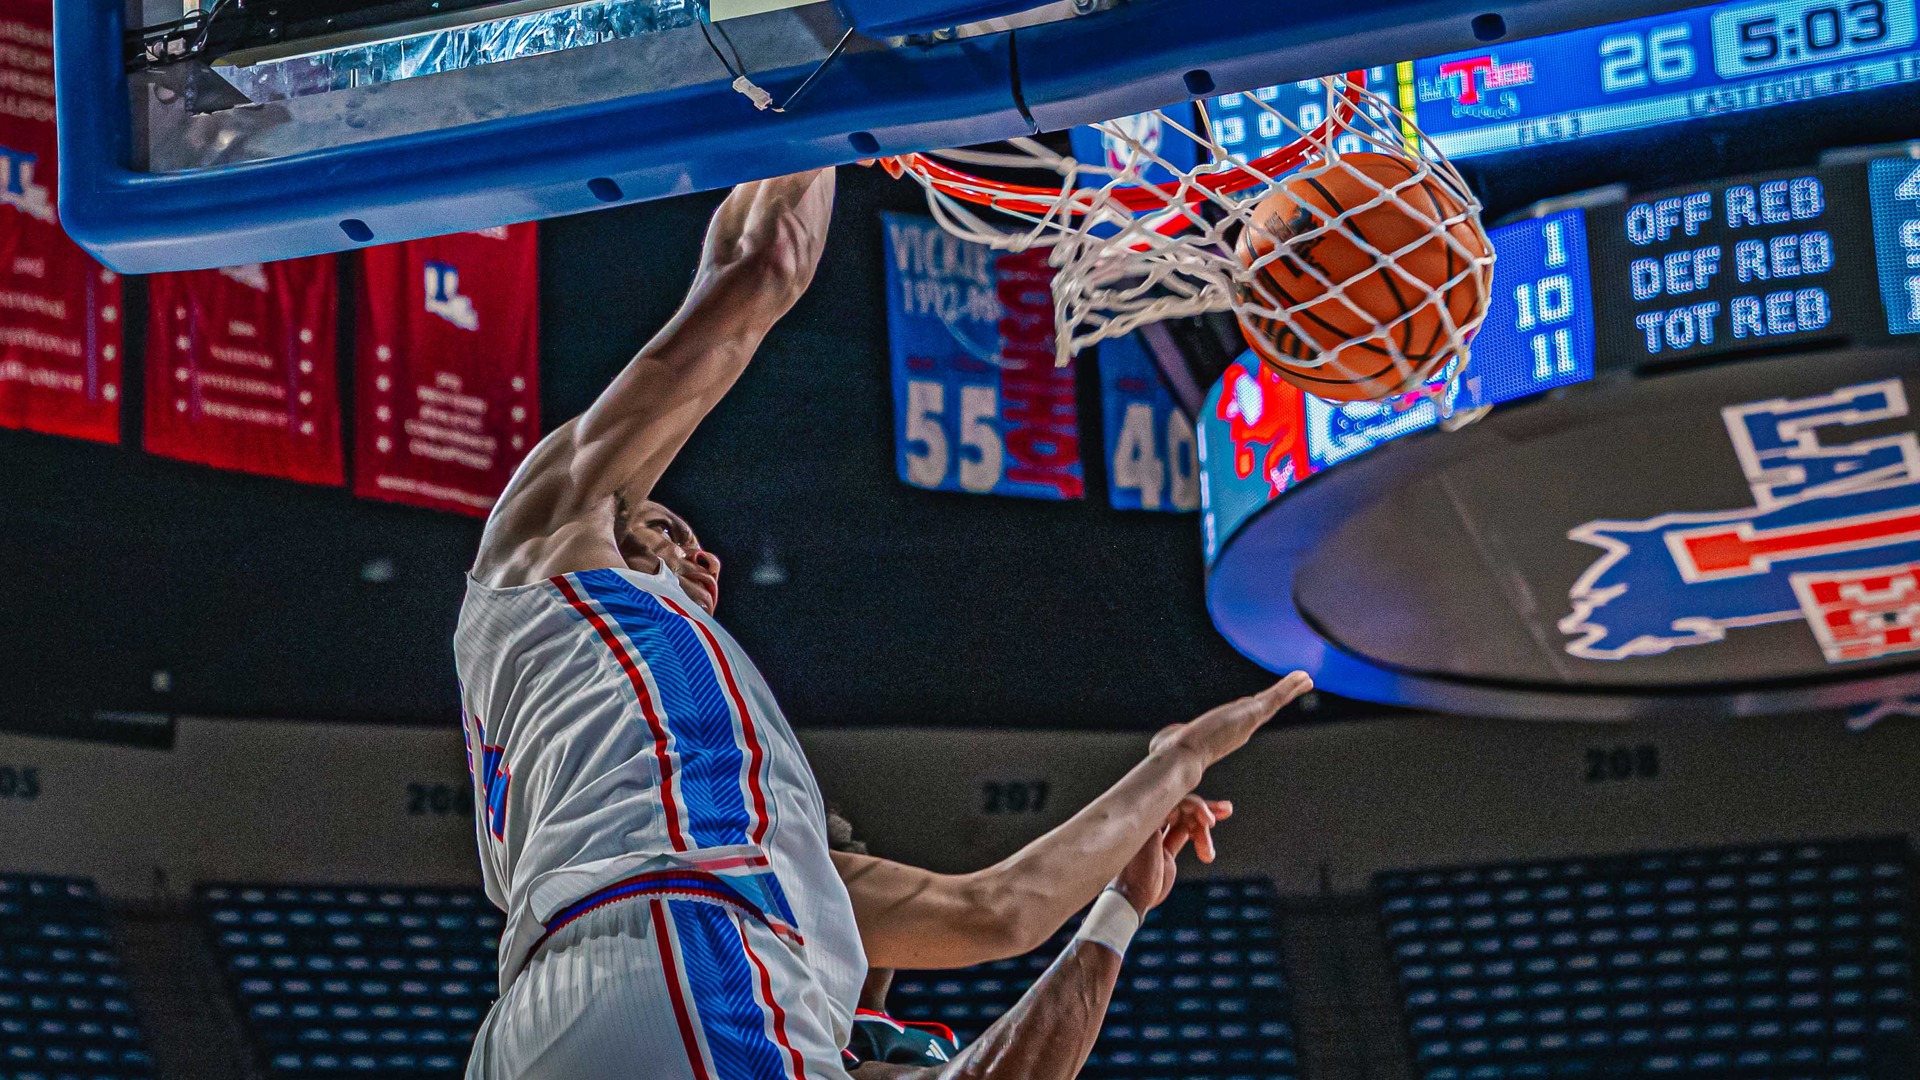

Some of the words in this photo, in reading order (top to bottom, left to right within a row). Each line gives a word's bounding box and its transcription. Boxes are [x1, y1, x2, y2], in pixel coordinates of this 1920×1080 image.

[1600, 22, 1697, 93] 26
[1740, 0, 1887, 63] 5:03
[1625, 191, 1712, 246] OFF
[1725, 176, 1824, 228] REB
[1542, 220, 1566, 268] 1
[1630, 245, 1721, 300] DEF
[1735, 230, 1834, 282] REB
[1513, 274, 1574, 332] 10
[1635, 301, 1720, 354] TOT
[1730, 287, 1831, 339] REB
[1530, 328, 1575, 382] 11
[906, 380, 1002, 494] 55
[1114, 403, 1200, 511] 40
[1585, 744, 1660, 783] 208
[983, 781, 1051, 813] 207
